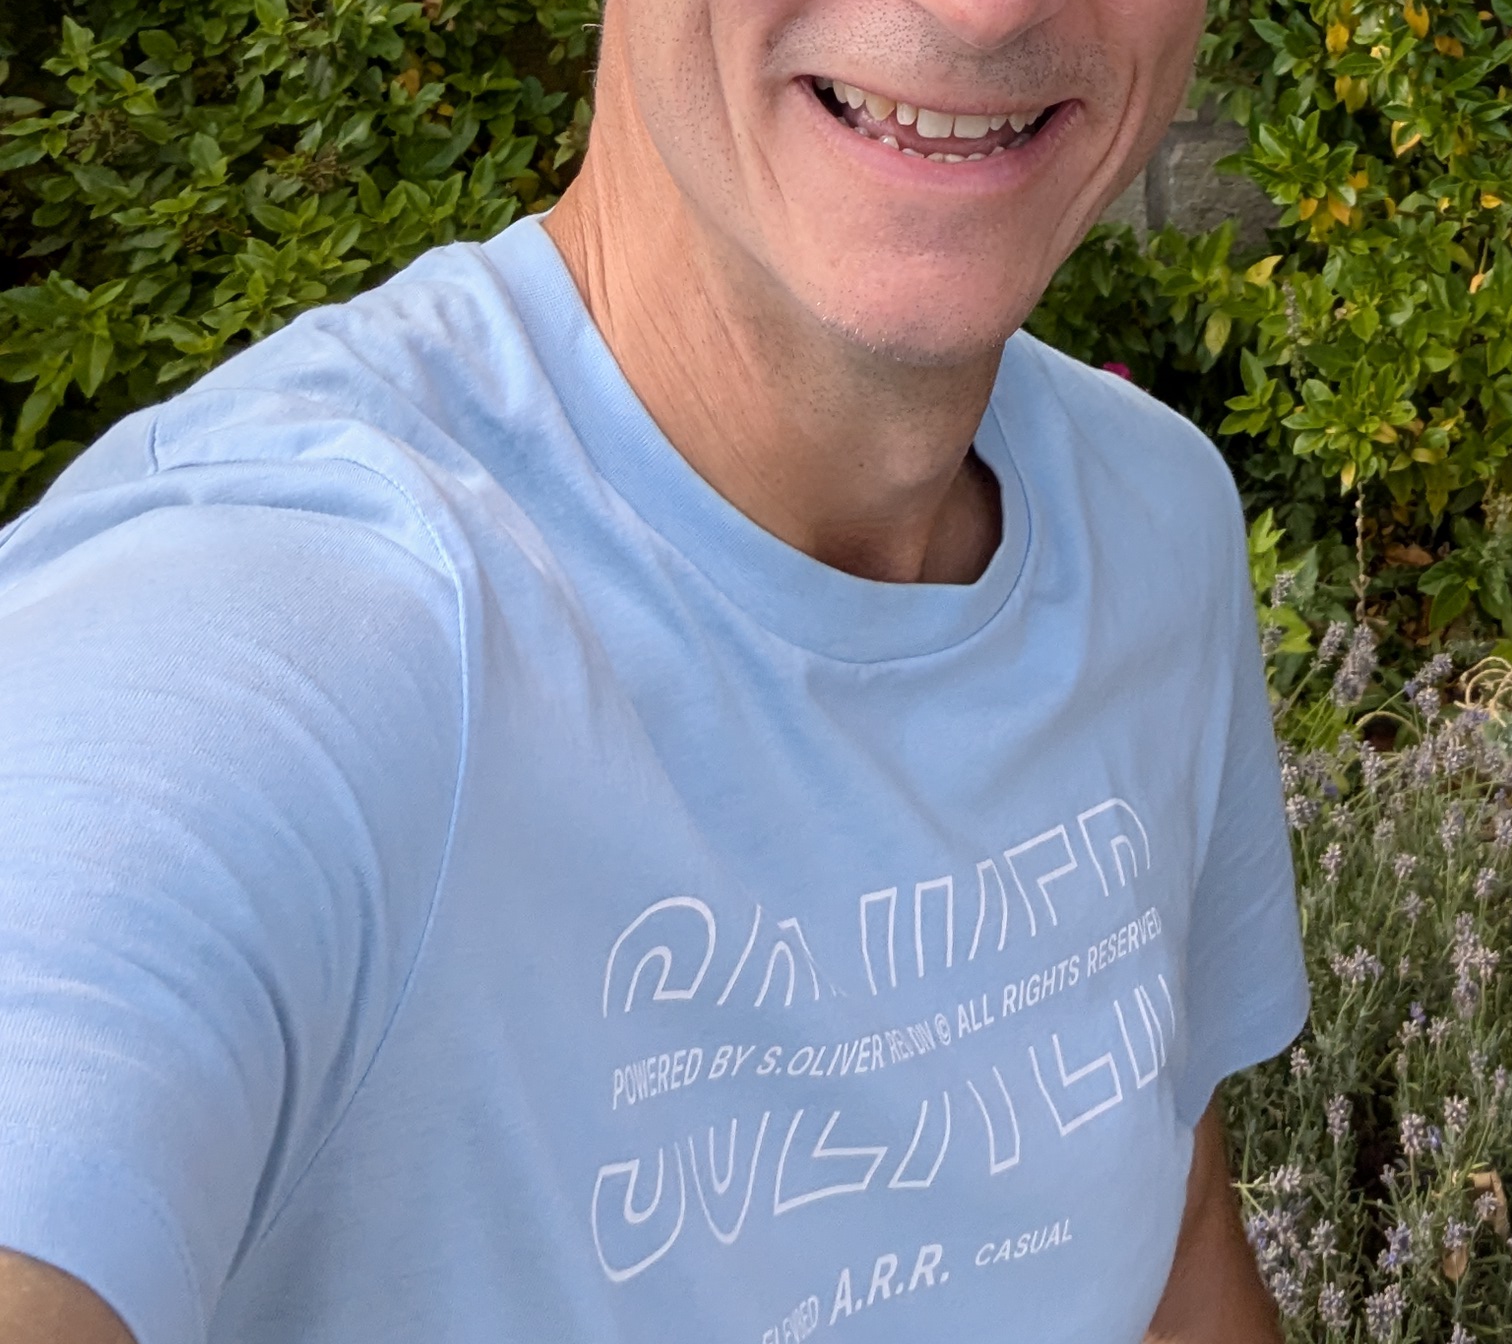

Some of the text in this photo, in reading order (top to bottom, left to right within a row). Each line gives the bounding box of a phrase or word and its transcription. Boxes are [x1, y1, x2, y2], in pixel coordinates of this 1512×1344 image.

[612, 1046, 703, 1111] POWERED
[708, 1044, 757, 1080] BY
[756, 1033, 885, 1076] S.OLIVER
[957, 993, 995, 1039] ALL
[1002, 954, 1080, 1018] RIGHTS
[1087, 906, 1163, 979] RESERVED
[829, 1243, 950, 1326] A.R.R.
[974, 1217, 1073, 1267] CASUAL
